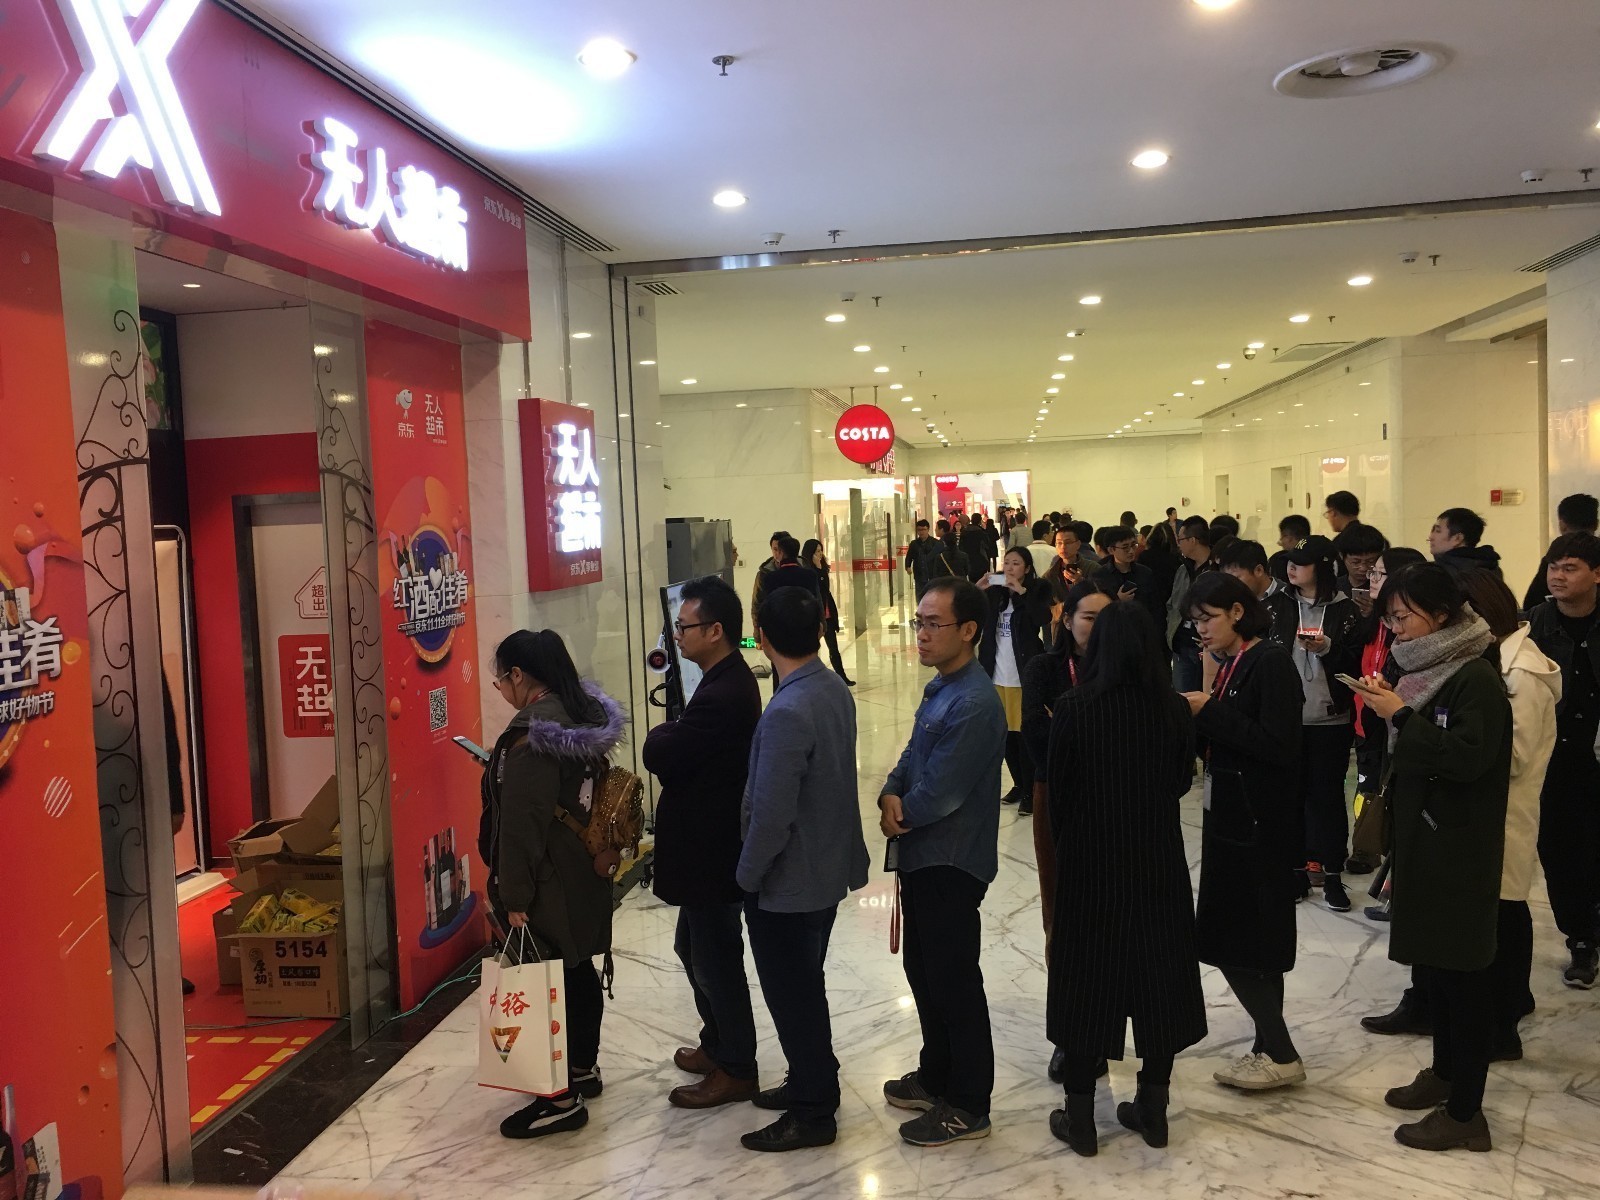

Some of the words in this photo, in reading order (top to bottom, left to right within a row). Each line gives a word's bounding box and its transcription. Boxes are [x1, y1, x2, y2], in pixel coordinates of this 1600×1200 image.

[425, 394, 443, 415] 无人
[398, 422, 415, 438] 京东
[425, 416, 444, 436] 超市
[839, 427, 890, 441] COSTA
[556, 423, 600, 487] 无人
[311, 584, 328, 598] 超
[393, 570, 468, 621] 红酒配佳肴
[313, 598, 329, 610] 出
[296, 646, 332, 680] 无
[296, 684, 330, 716] 超
[275, 941, 328, 958] 5154
